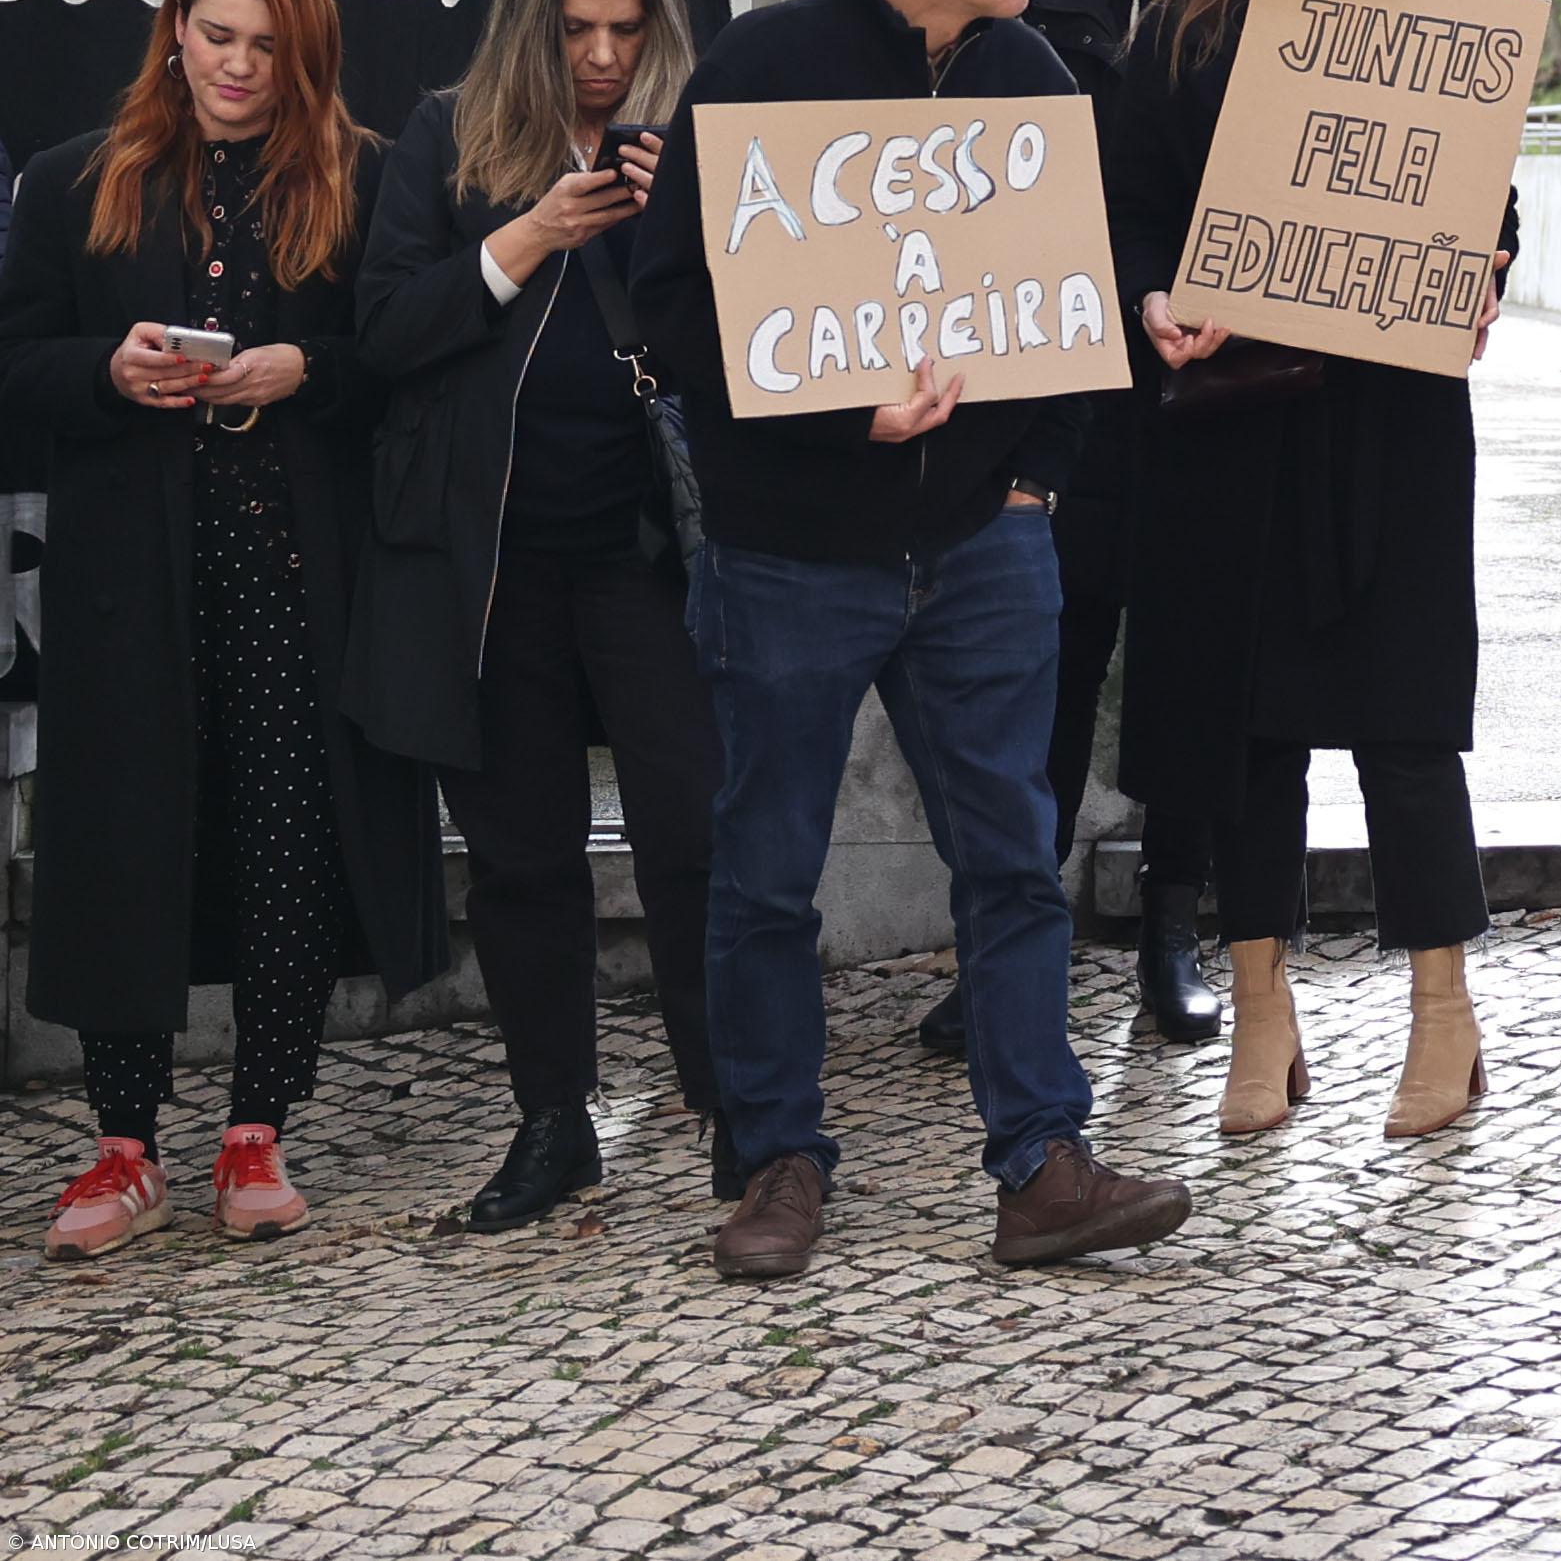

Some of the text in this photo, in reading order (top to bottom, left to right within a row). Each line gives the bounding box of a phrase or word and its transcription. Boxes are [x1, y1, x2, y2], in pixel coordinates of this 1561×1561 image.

[725, 118, 1047, 255] ACESSO
[1291, 110, 1440, 206] PELA
[883, 222, 945, 297] À
[1185, 207, 1493, 331] EDUCAÇÃO
